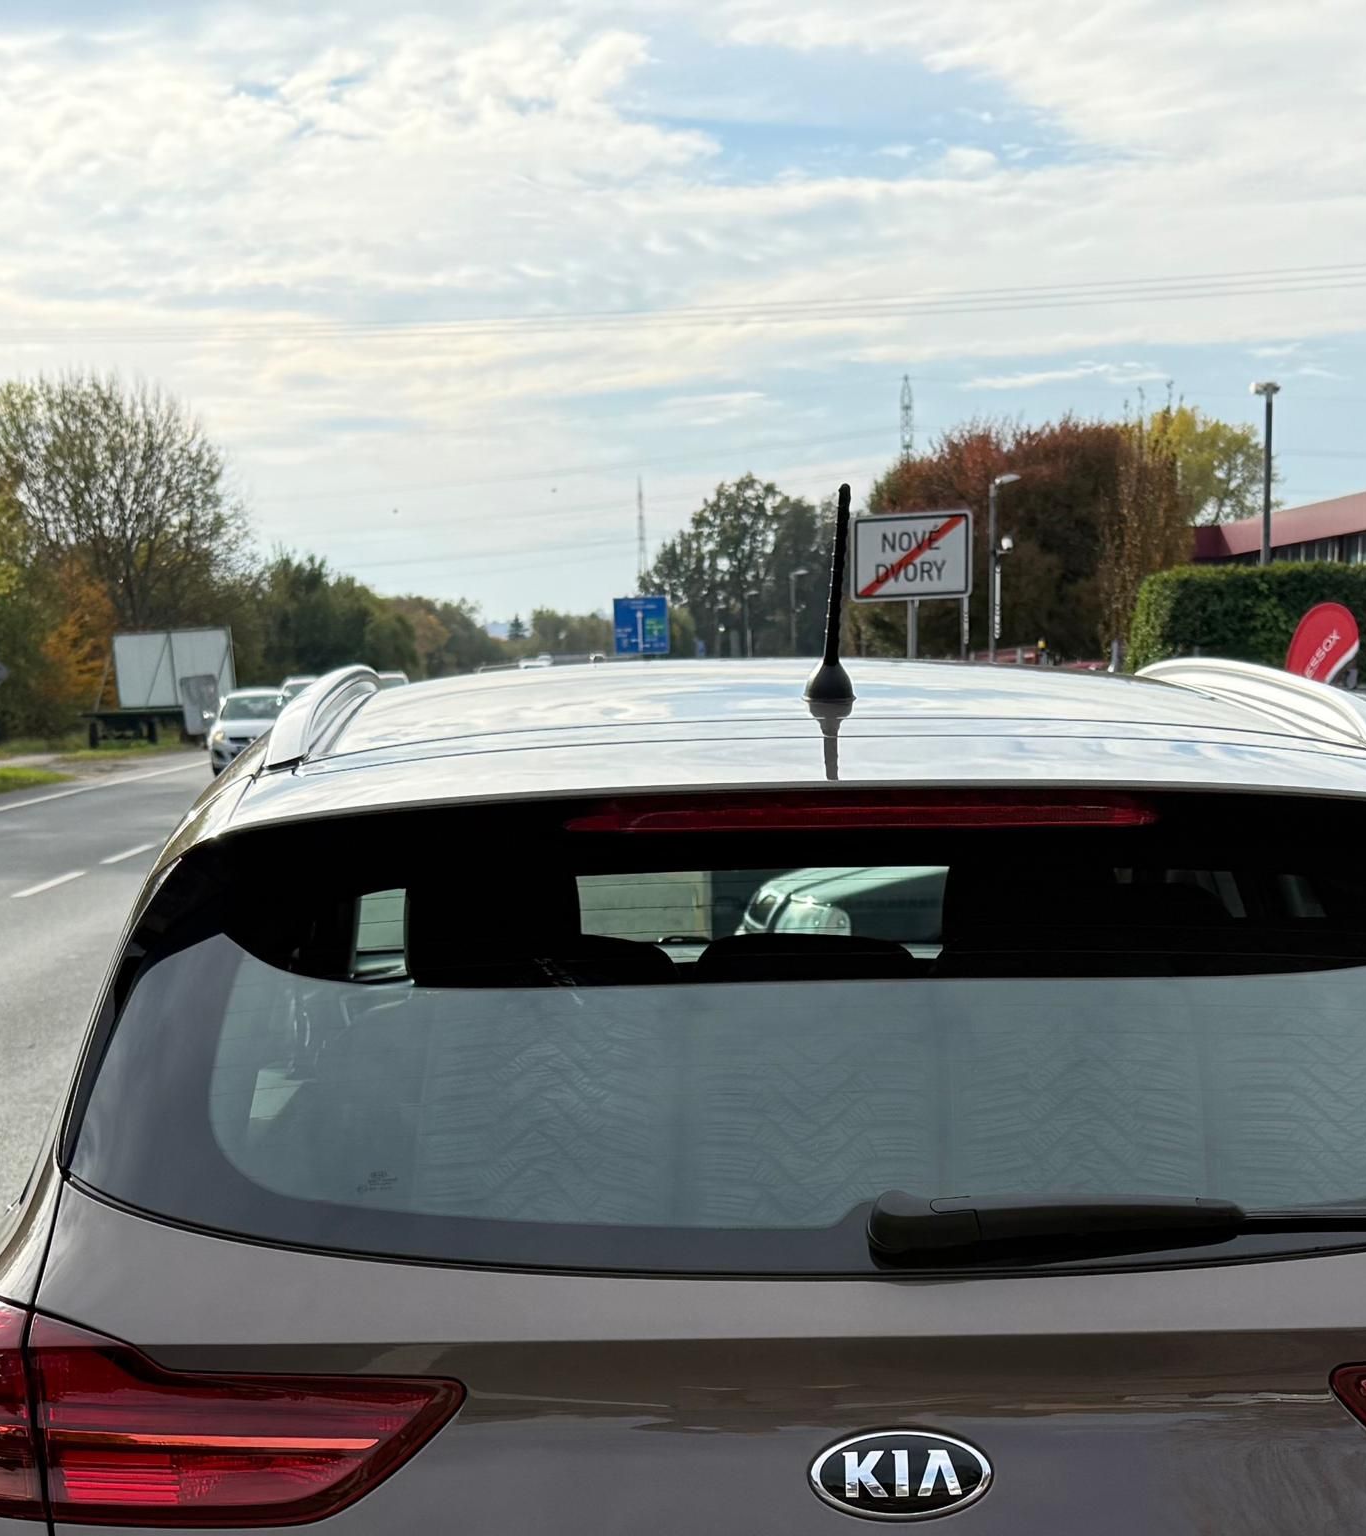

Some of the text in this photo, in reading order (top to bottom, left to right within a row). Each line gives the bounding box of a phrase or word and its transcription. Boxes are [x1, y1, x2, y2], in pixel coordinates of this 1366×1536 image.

[881, 524, 941, 553] NOVÉ
[875, 560, 946, 583] DVORY
[1304, 629, 1341, 679] ESSOX
[841, 1449, 963, 1498] KIA
